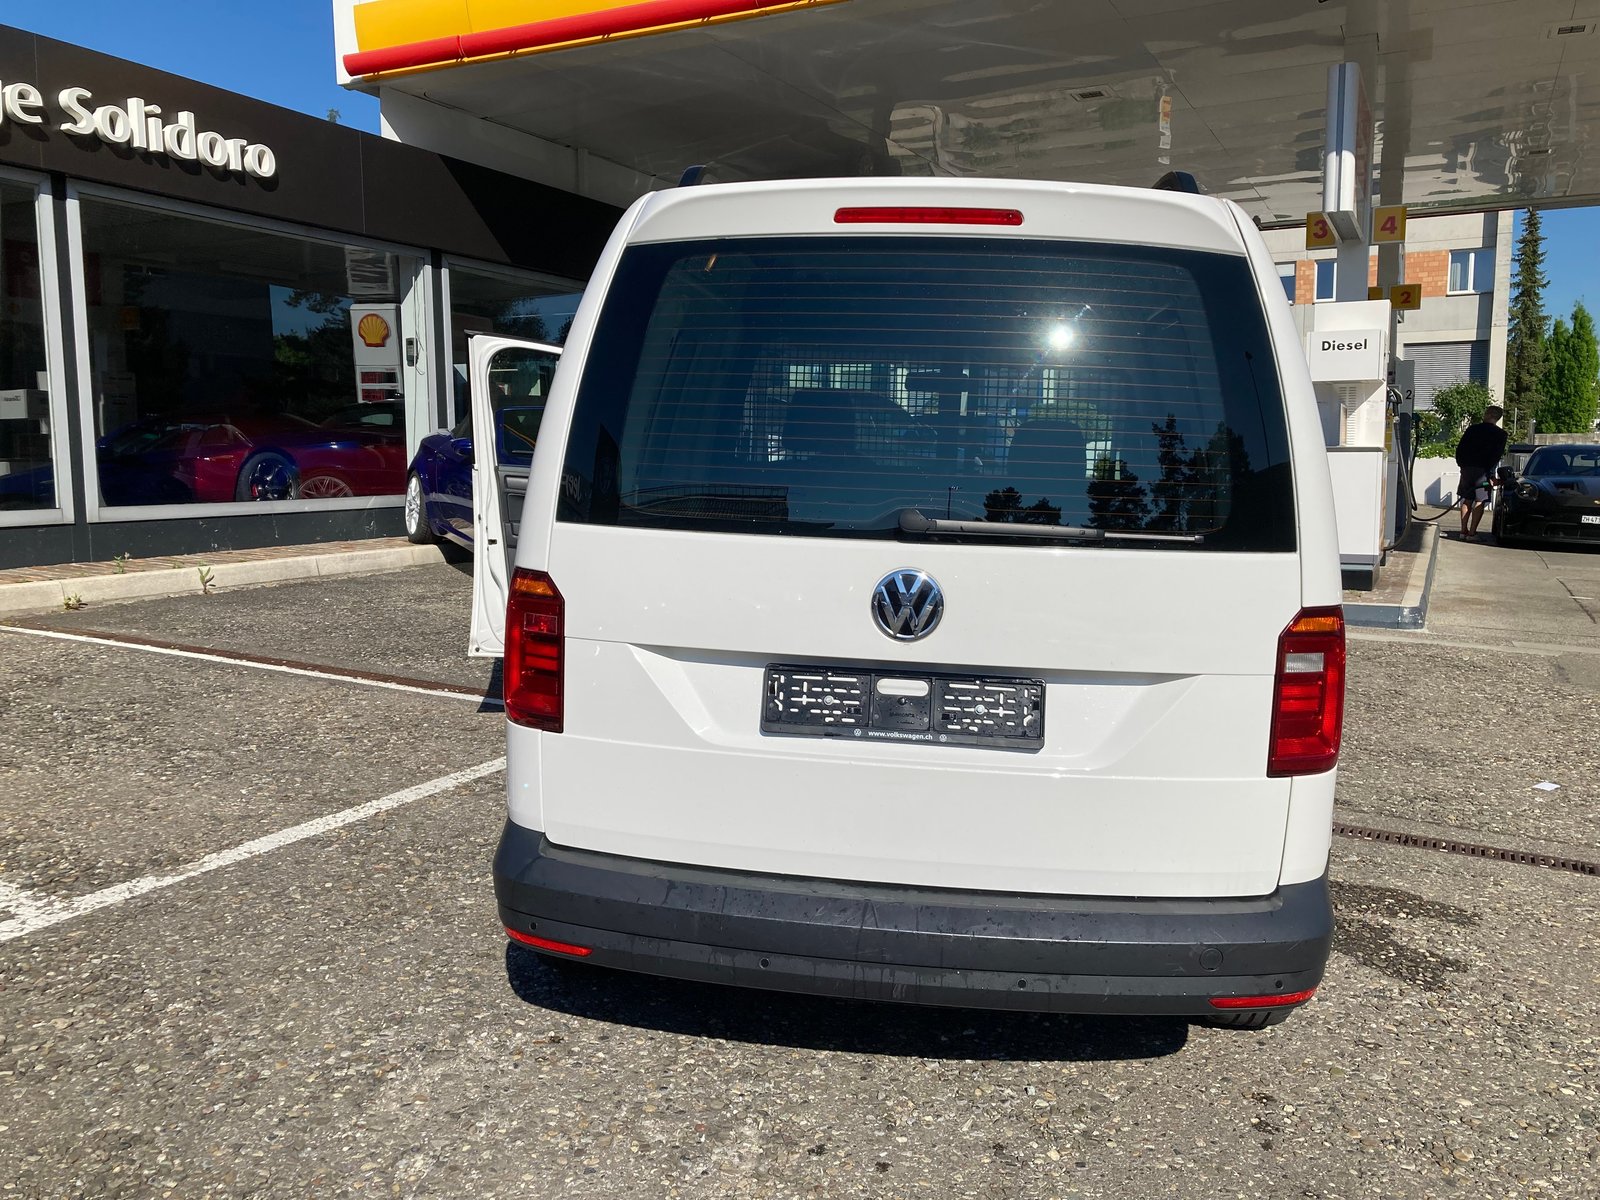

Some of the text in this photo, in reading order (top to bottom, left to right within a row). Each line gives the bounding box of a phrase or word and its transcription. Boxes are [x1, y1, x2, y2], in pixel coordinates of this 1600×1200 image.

[0, 80, 276, 178] e Solidoro
[1313, 220, 1328, 239] 3
[1380, 215, 1397, 235] 4
[1400, 291, 1411, 305] 2
[1321, 338, 1368, 351] Diesel
[1405, 389, 1413, 400] 2
[867, 731, 933, 741] www.volkswagen.ch
